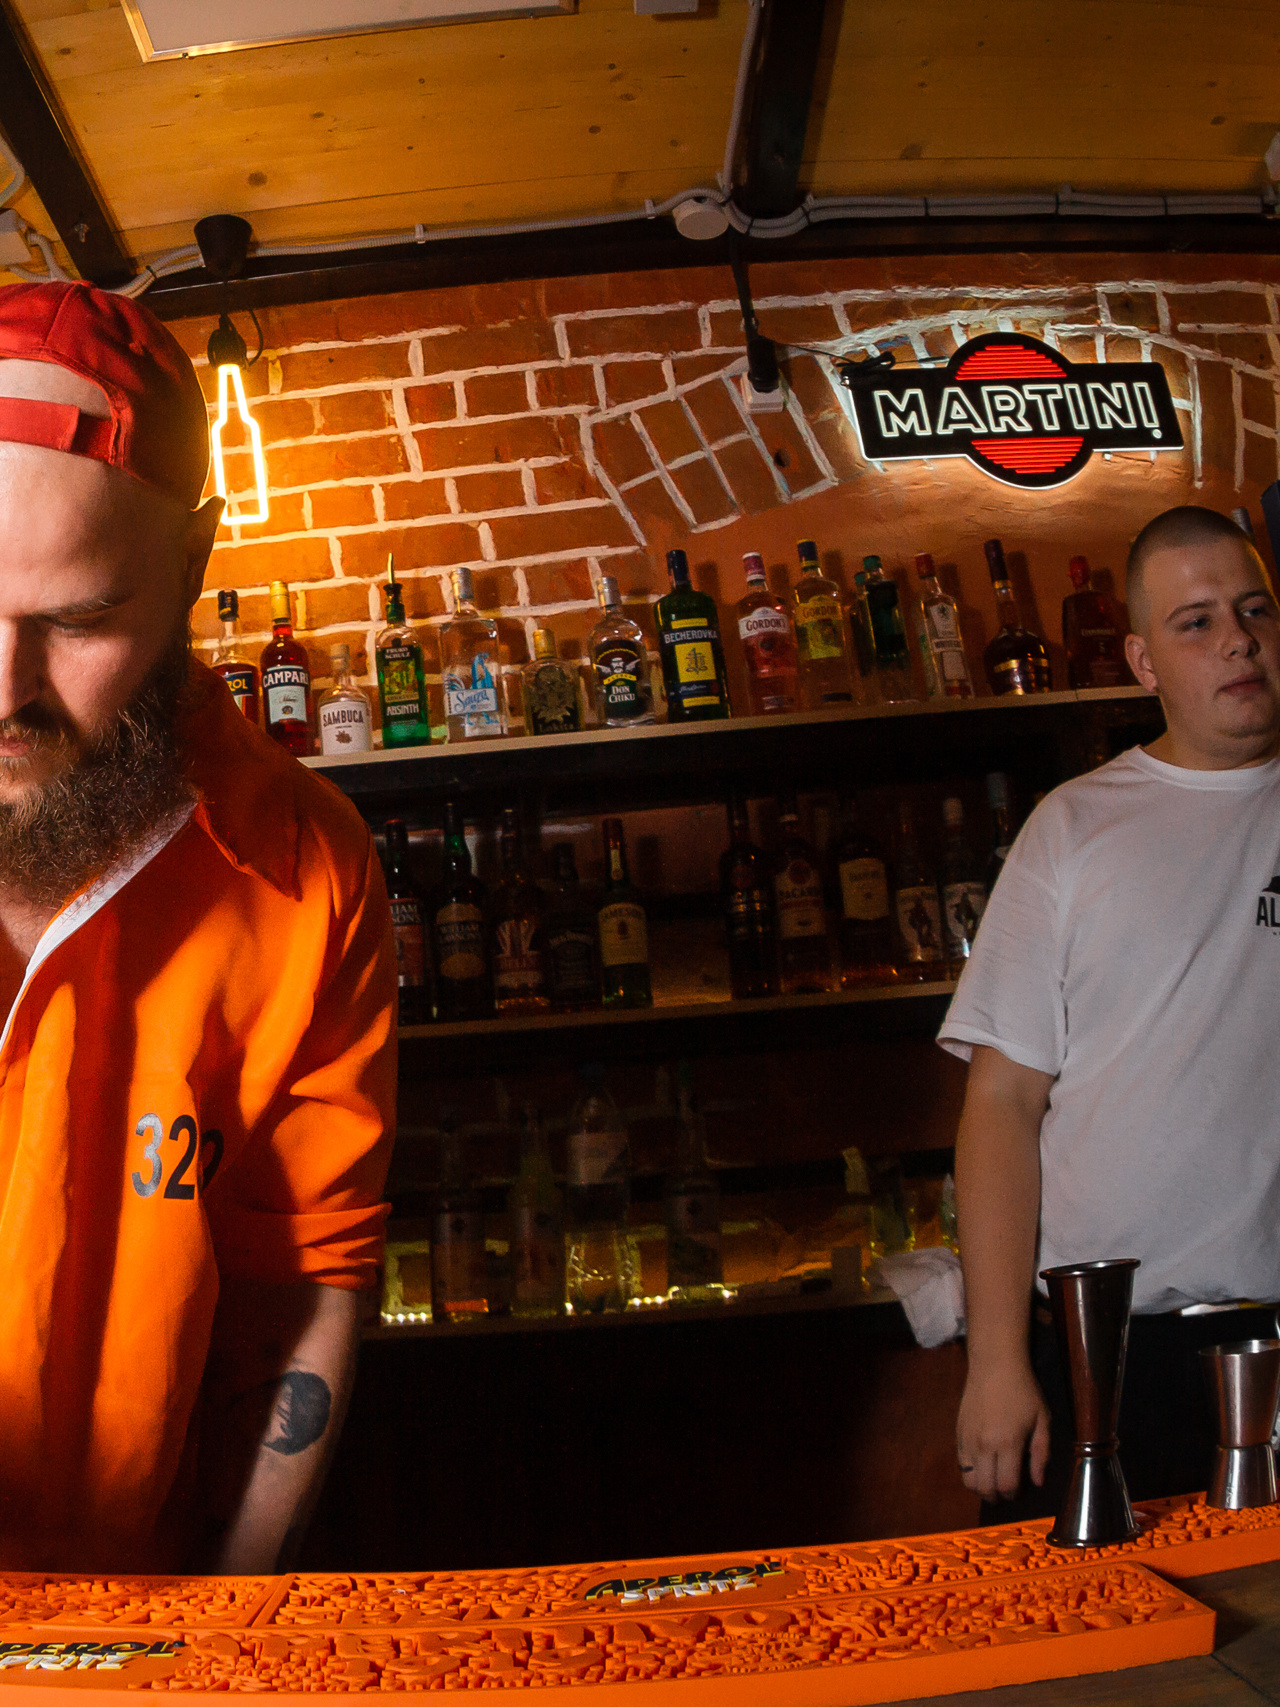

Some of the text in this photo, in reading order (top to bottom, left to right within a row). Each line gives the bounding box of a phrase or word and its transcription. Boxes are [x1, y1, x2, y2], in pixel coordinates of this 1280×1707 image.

[873, 381, 1160, 438] MARTINI
[663, 628, 718, 644] BECHEROVKA
[611, 685, 631, 695] DON
[322, 709, 364, 727] SAMBUCA
[386, 703, 420, 717] ABSINTH
[131, 1112, 225, 1200] 322
[585, 1561, 786, 1601] APEROL
[620, 1576, 757, 1605] SPRITZ
